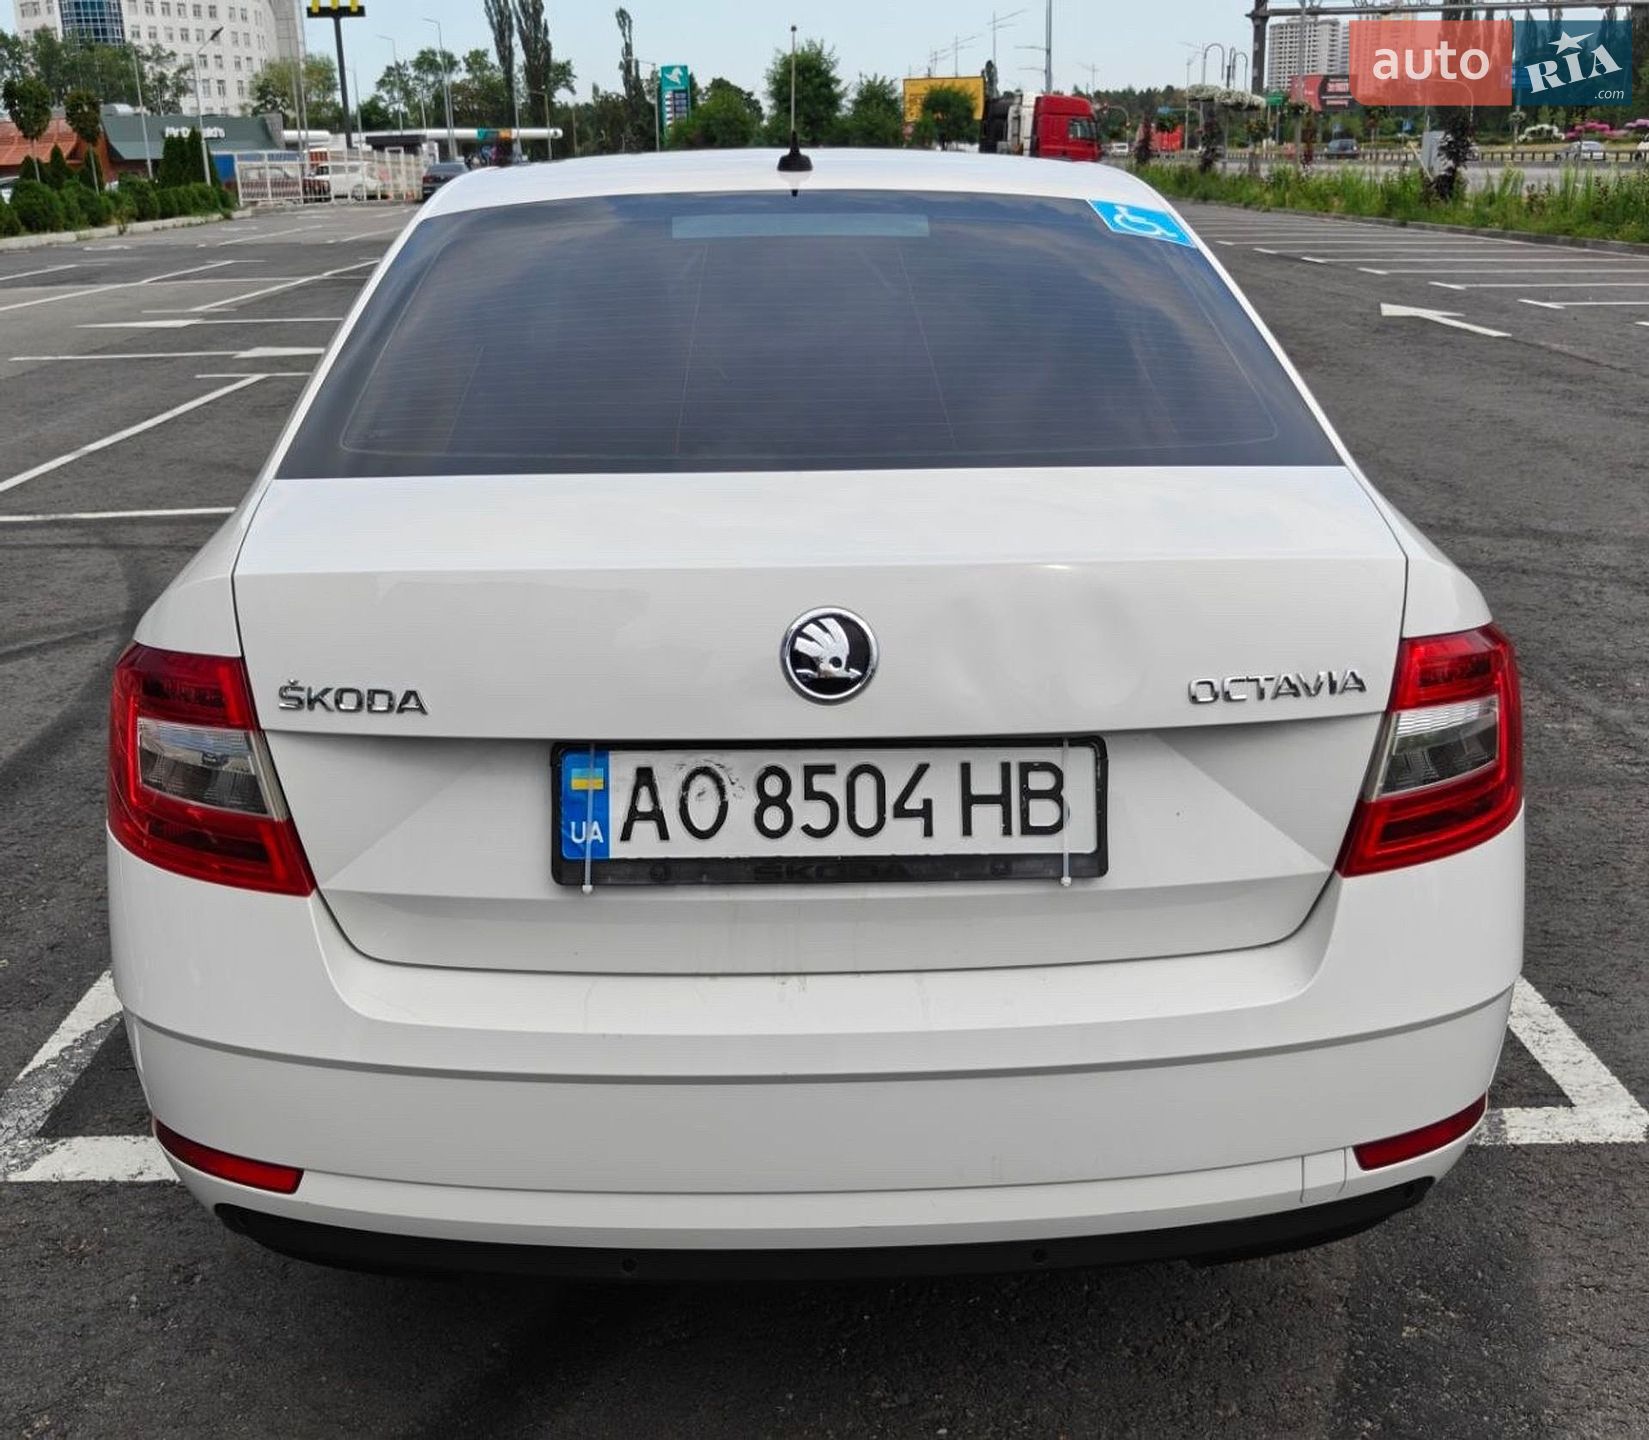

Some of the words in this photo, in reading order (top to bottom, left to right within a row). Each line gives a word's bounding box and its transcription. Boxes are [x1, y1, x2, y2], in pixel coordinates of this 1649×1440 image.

[279, 678, 428, 715] ŠKODA
[1188, 668, 1367, 704] OCTAVIA
[620, 766, 729, 841] AO
[754, 762, 933, 839] 8504
[960, 762, 1069, 836] HB
[571, 821, 604, 844] UA
